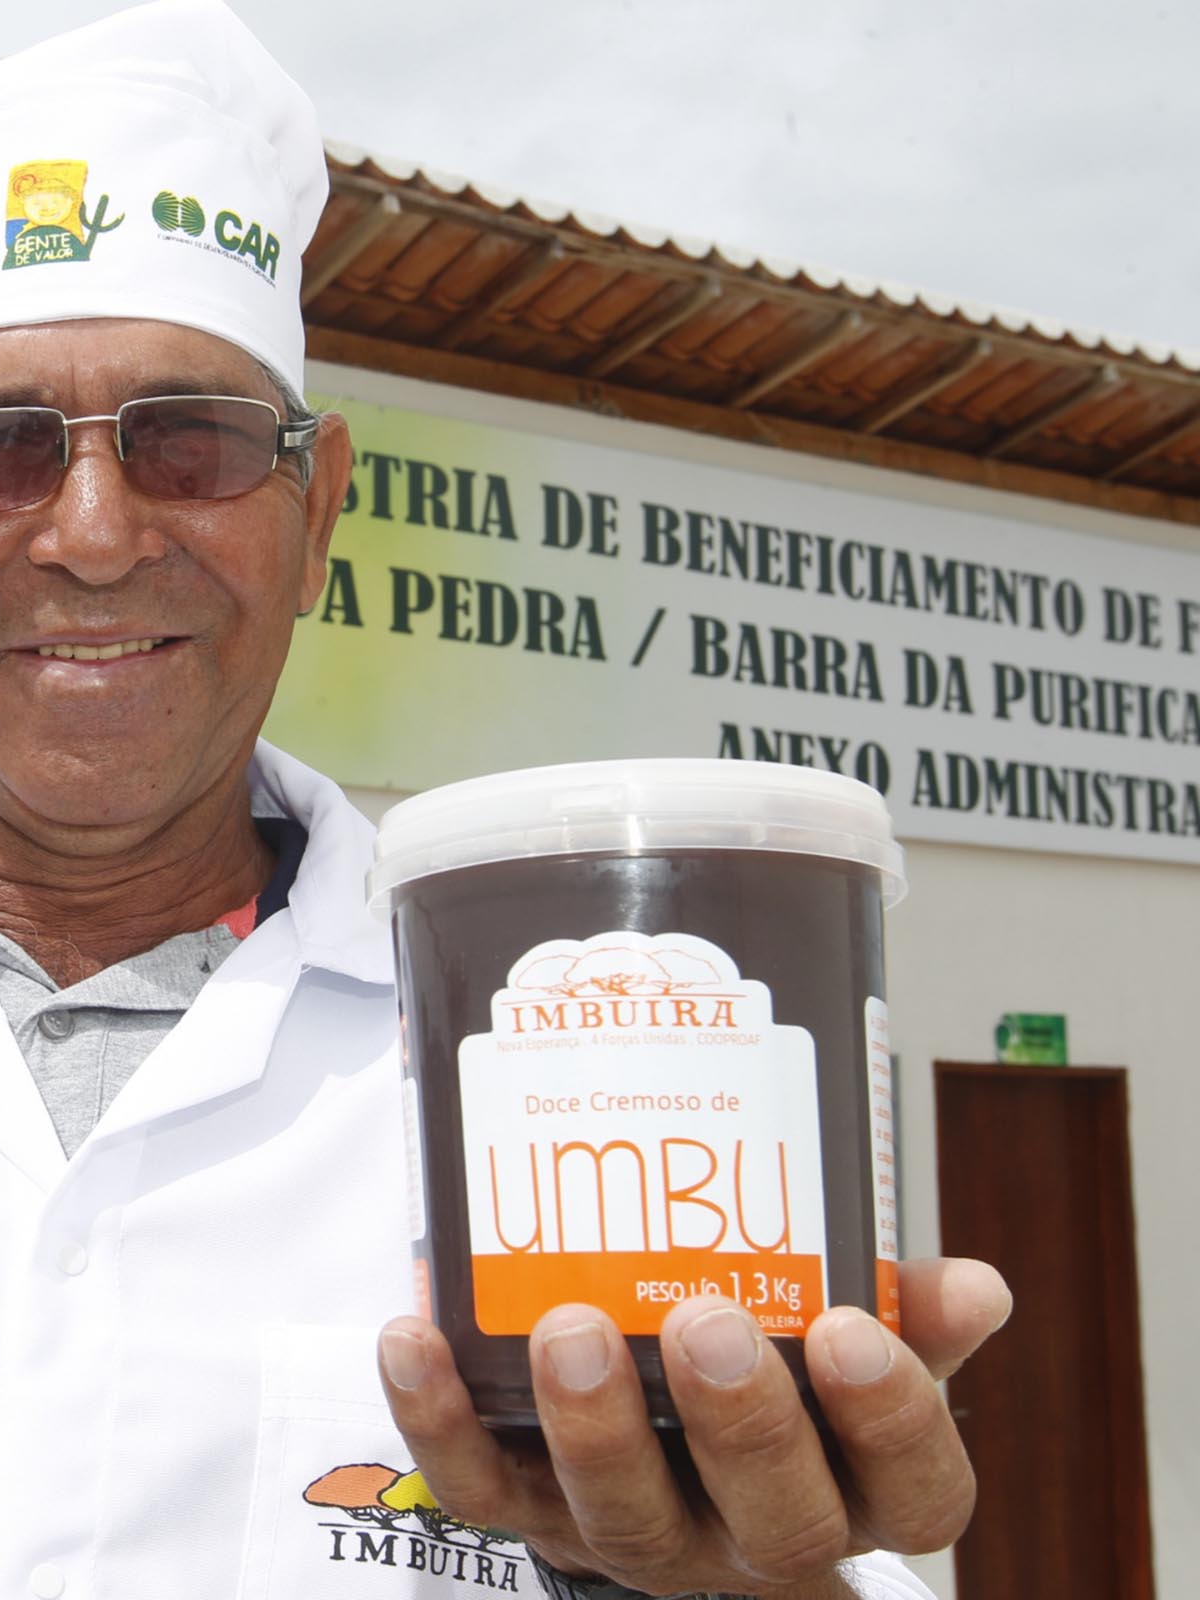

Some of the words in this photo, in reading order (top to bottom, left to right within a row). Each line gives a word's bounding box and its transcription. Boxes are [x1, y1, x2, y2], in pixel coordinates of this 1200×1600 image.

[14, 232, 72, 254] GENTE
[15, 252, 31, 267] DE
[35, 247, 74, 262] VALOR
[214, 209, 281, 282] CAR
[541, 482, 620, 559] DE
[641, 500, 1086, 637] BENEFICIAMENTO
[1101, 586, 1163, 651] DE
[388, 565, 608, 662] PEDRA
[629, 607, 667, 667] /
[690, 613, 884, 702] BARRA
[903, 647, 974, 716] DA
[511, 999, 739, 1034] IMBUIRA
[643, 1031, 687, 1046] Unidas
[525, 1094, 581, 1115] Doce
[590, 1091, 702, 1113] Cremoso
[711, 1091, 741, 1112] de
[635, 1280, 685, 1303] PESO
[773, 1277, 801, 1311] Kg
[757, 1314, 804, 1329] SILEIRA
[329, 1530, 519, 1592] IMBUIRA
